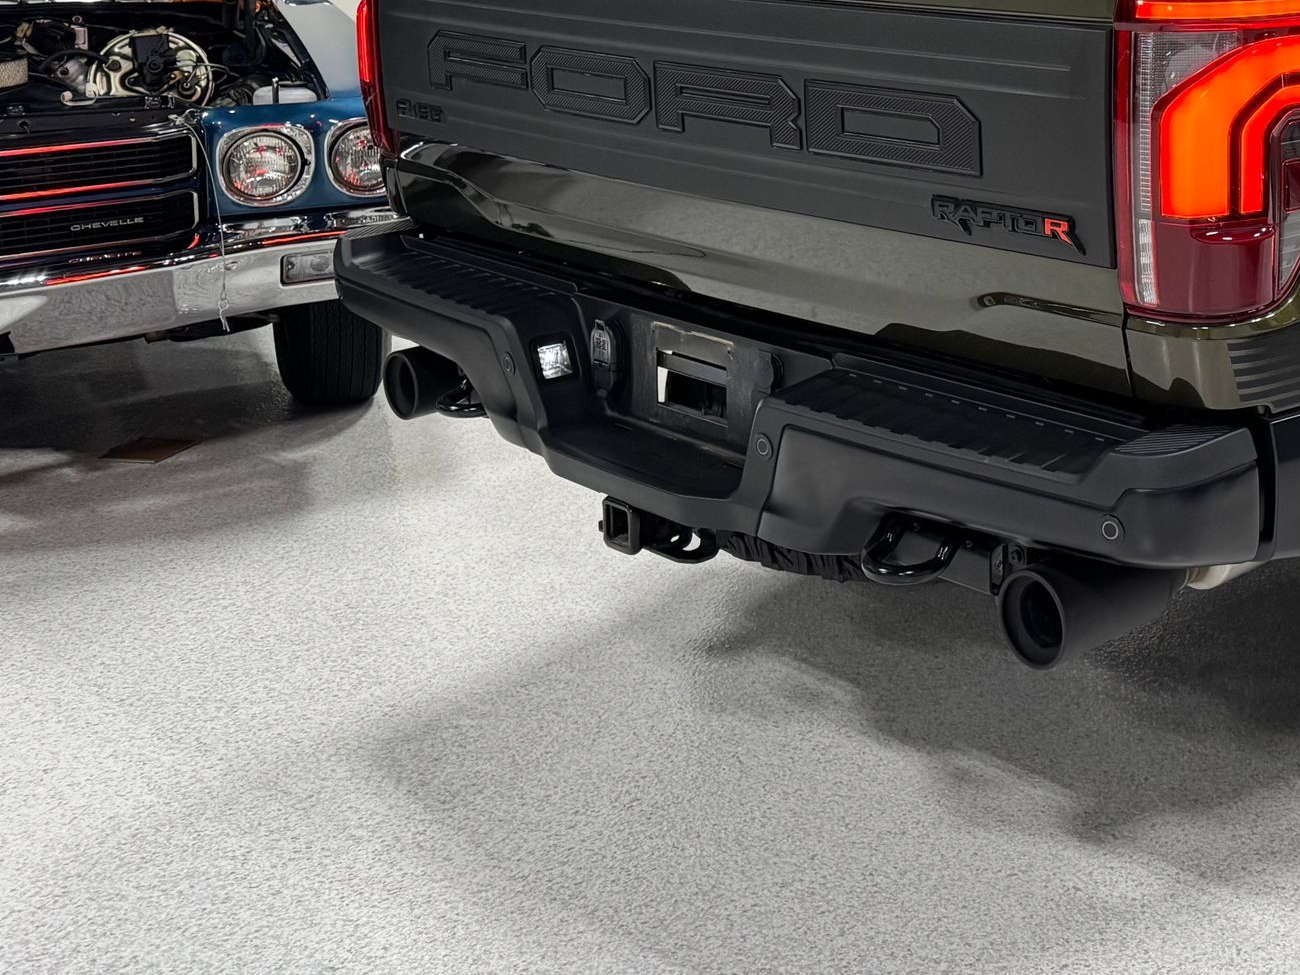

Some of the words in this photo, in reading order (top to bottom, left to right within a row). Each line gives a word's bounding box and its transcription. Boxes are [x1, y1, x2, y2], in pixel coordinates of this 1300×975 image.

[427, 29, 983, 177] FORD
[70, 216, 144, 231] CHEVELLE
[930, 193, 1087, 257] RAPTOR
